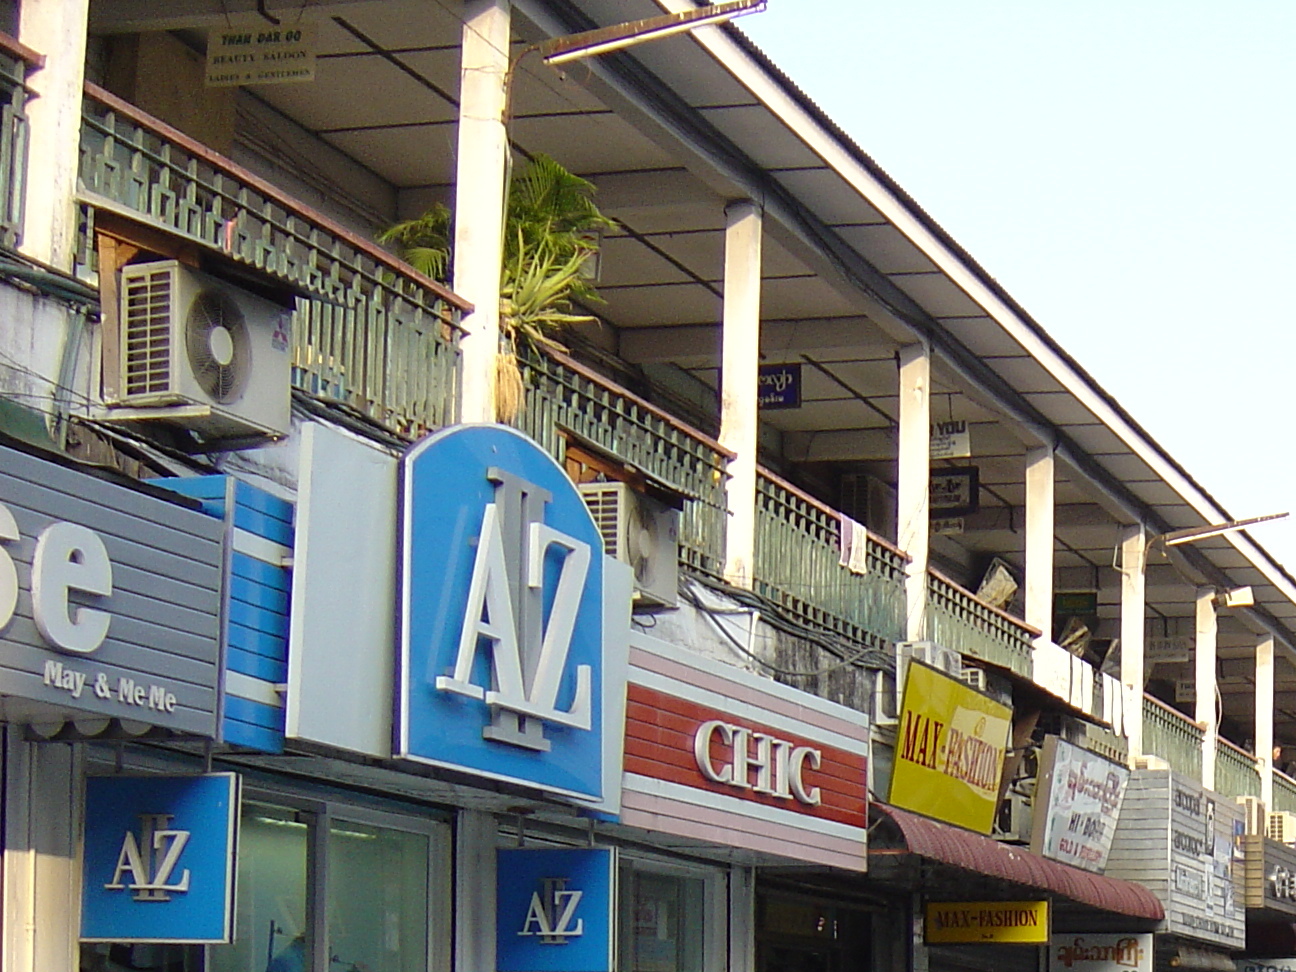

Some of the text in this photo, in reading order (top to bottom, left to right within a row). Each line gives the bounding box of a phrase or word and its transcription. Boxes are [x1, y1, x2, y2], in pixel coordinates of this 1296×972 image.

[936, 419, 966, 436] YOU
[44, 660, 86, 698] May
[94, 672, 112, 699] &
[695, 720, 821, 807] CHIC
[937, 909, 1039, 928] MAX-FASHION
